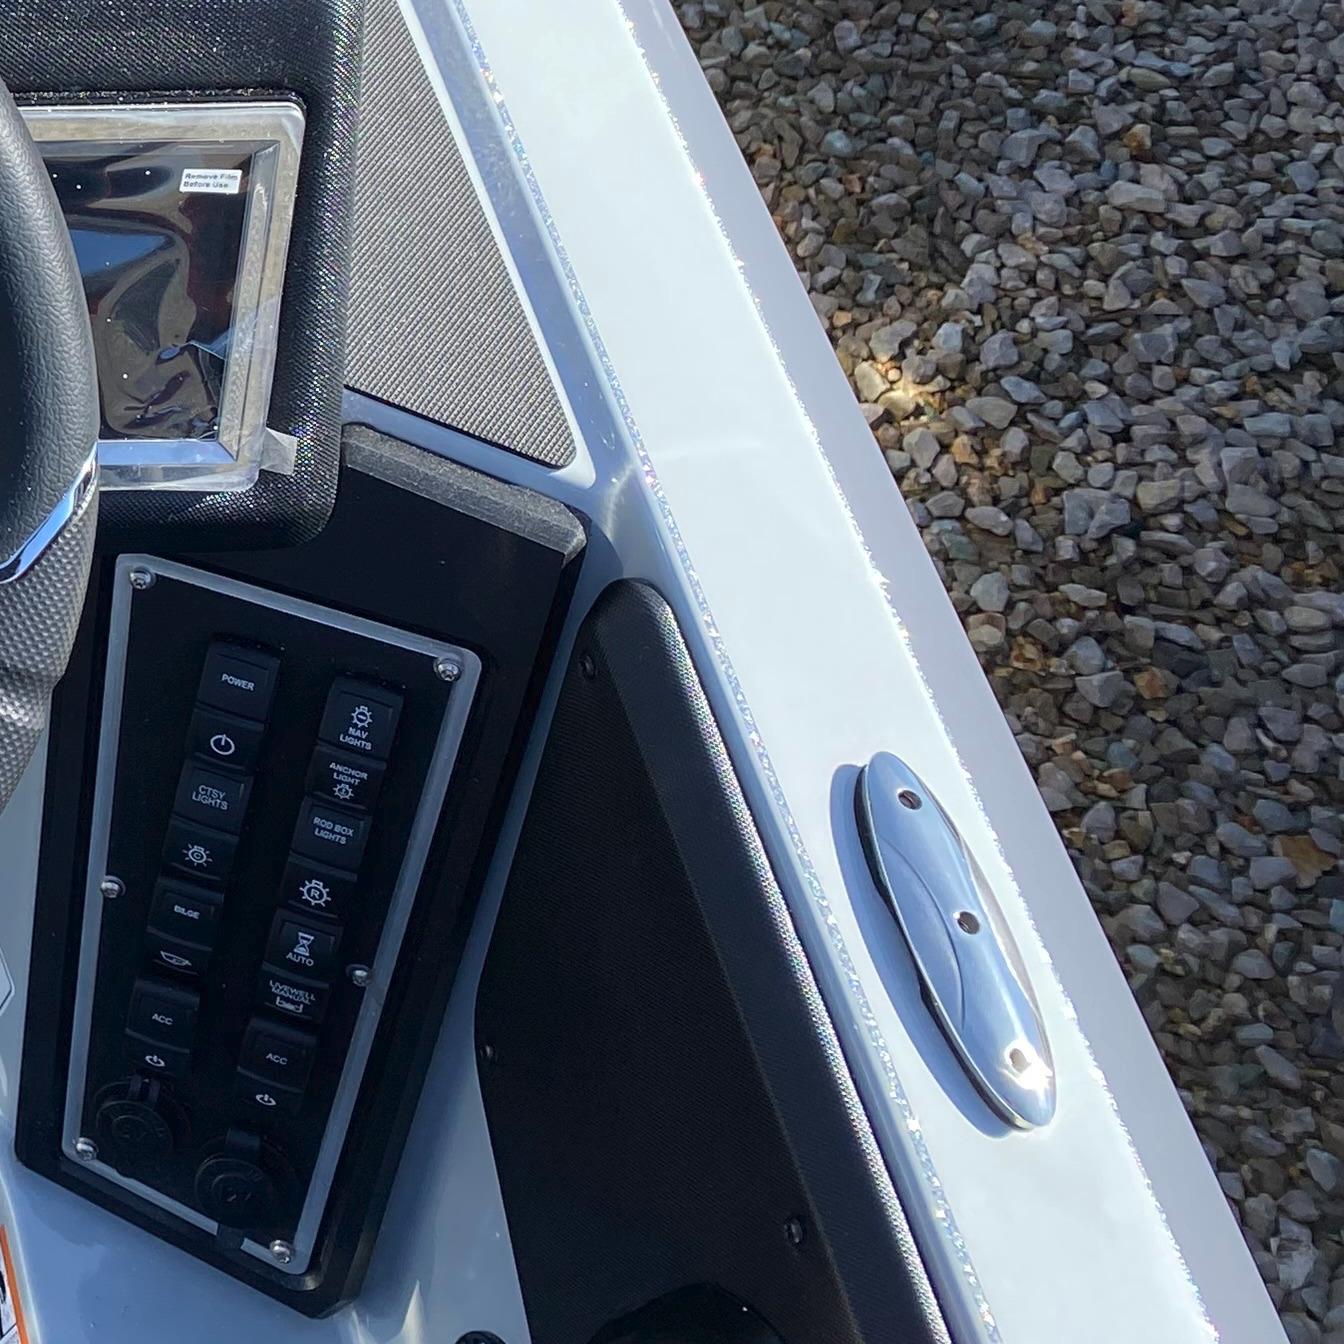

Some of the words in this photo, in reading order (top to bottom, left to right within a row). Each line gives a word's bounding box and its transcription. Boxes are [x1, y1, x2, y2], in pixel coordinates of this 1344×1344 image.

[221, 673, 255, 691] POWER
[347, 726, 369, 739] NAV
[340, 733, 372, 751] LIGHTS
[329, 761, 368, 780] ANCHOR
[333, 772, 361, 786] LIGHT
[198, 784, 226, 800] CTSY
[192, 793, 229, 811] LIGHTS
[313, 816, 334, 830] ROD
[334, 822, 355, 837] BOX
[314, 827, 347, 845] LIGHTS
[174, 905, 200, 919] BILGE
[285, 952, 314, 967] AUTO
[269, 979, 316, 1001] LIVEWELL
[152, 1012, 174, 1026] ACC
[265, 1052, 288, 1066] ACC
